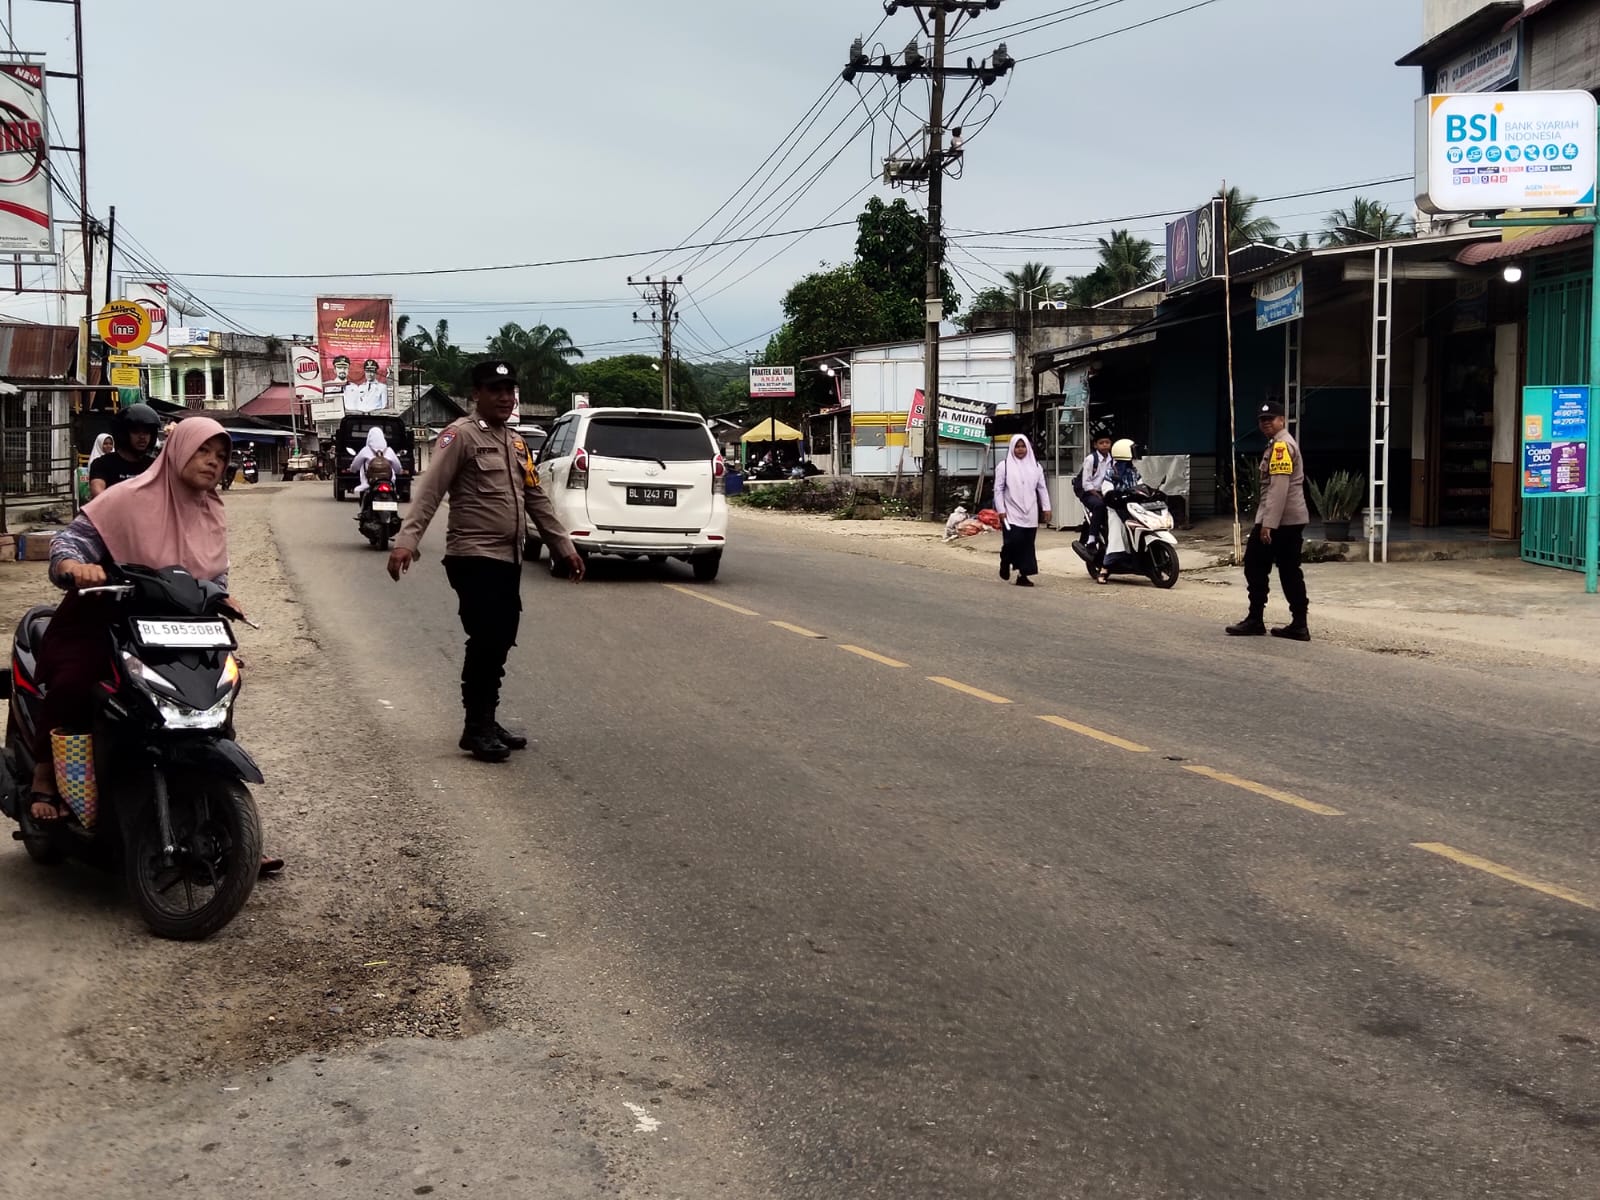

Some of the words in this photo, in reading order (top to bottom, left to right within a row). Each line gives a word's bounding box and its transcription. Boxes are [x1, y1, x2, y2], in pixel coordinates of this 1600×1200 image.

[15, 67, 41, 84] NEW
[1446, 113, 1497, 142] BSI
[1504, 121, 1534, 131] BANK
[1536, 119, 1579, 130] SYARIAH
[1504, 131, 1562, 142] INDONESIA
[335, 317, 375, 329] Selamat
[947, 425, 960, 434] 35
[629, 488, 638, 498] BL
[643, 489, 660, 499] 1243
[142, 623, 161, 635] BL
